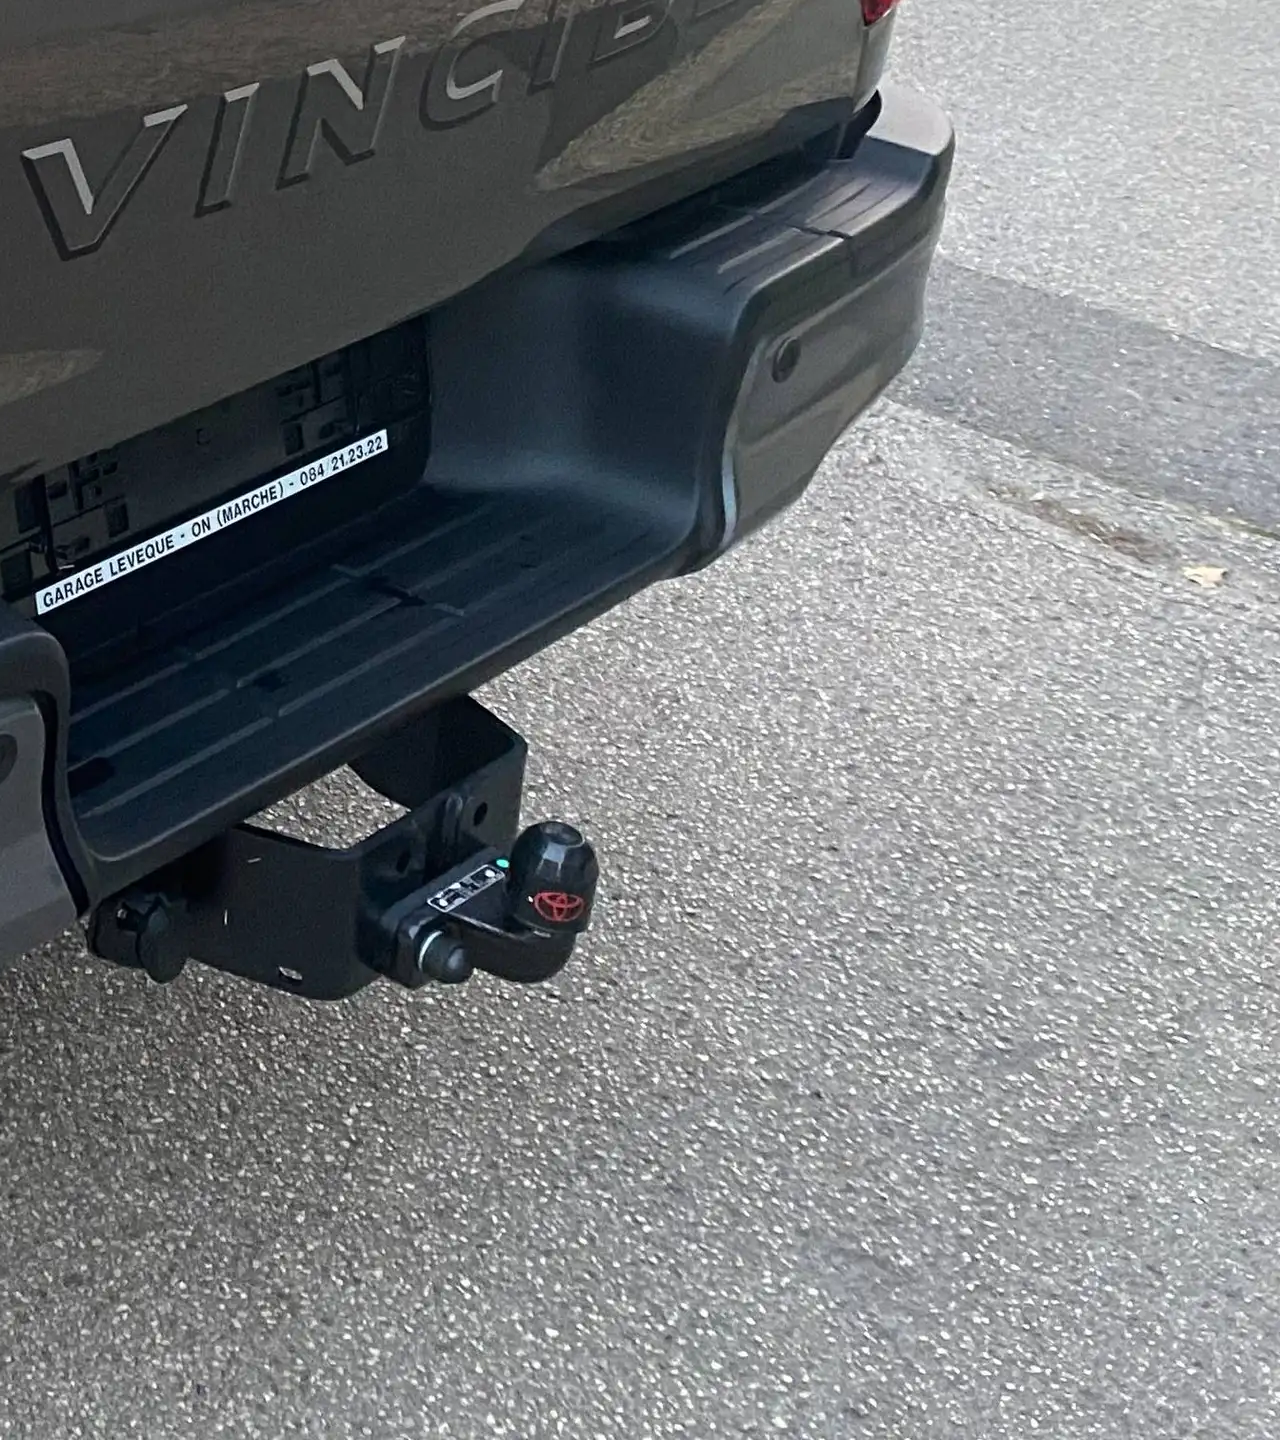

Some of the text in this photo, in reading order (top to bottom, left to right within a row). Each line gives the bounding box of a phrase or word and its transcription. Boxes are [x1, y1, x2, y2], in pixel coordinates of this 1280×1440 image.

[43, 567, 104, 608] GARAGE
[109, 534, 175, 577] LEVEQUE
[191, 516, 211, 538] ON
[216, 480, 284, 527] (MARCHE)
